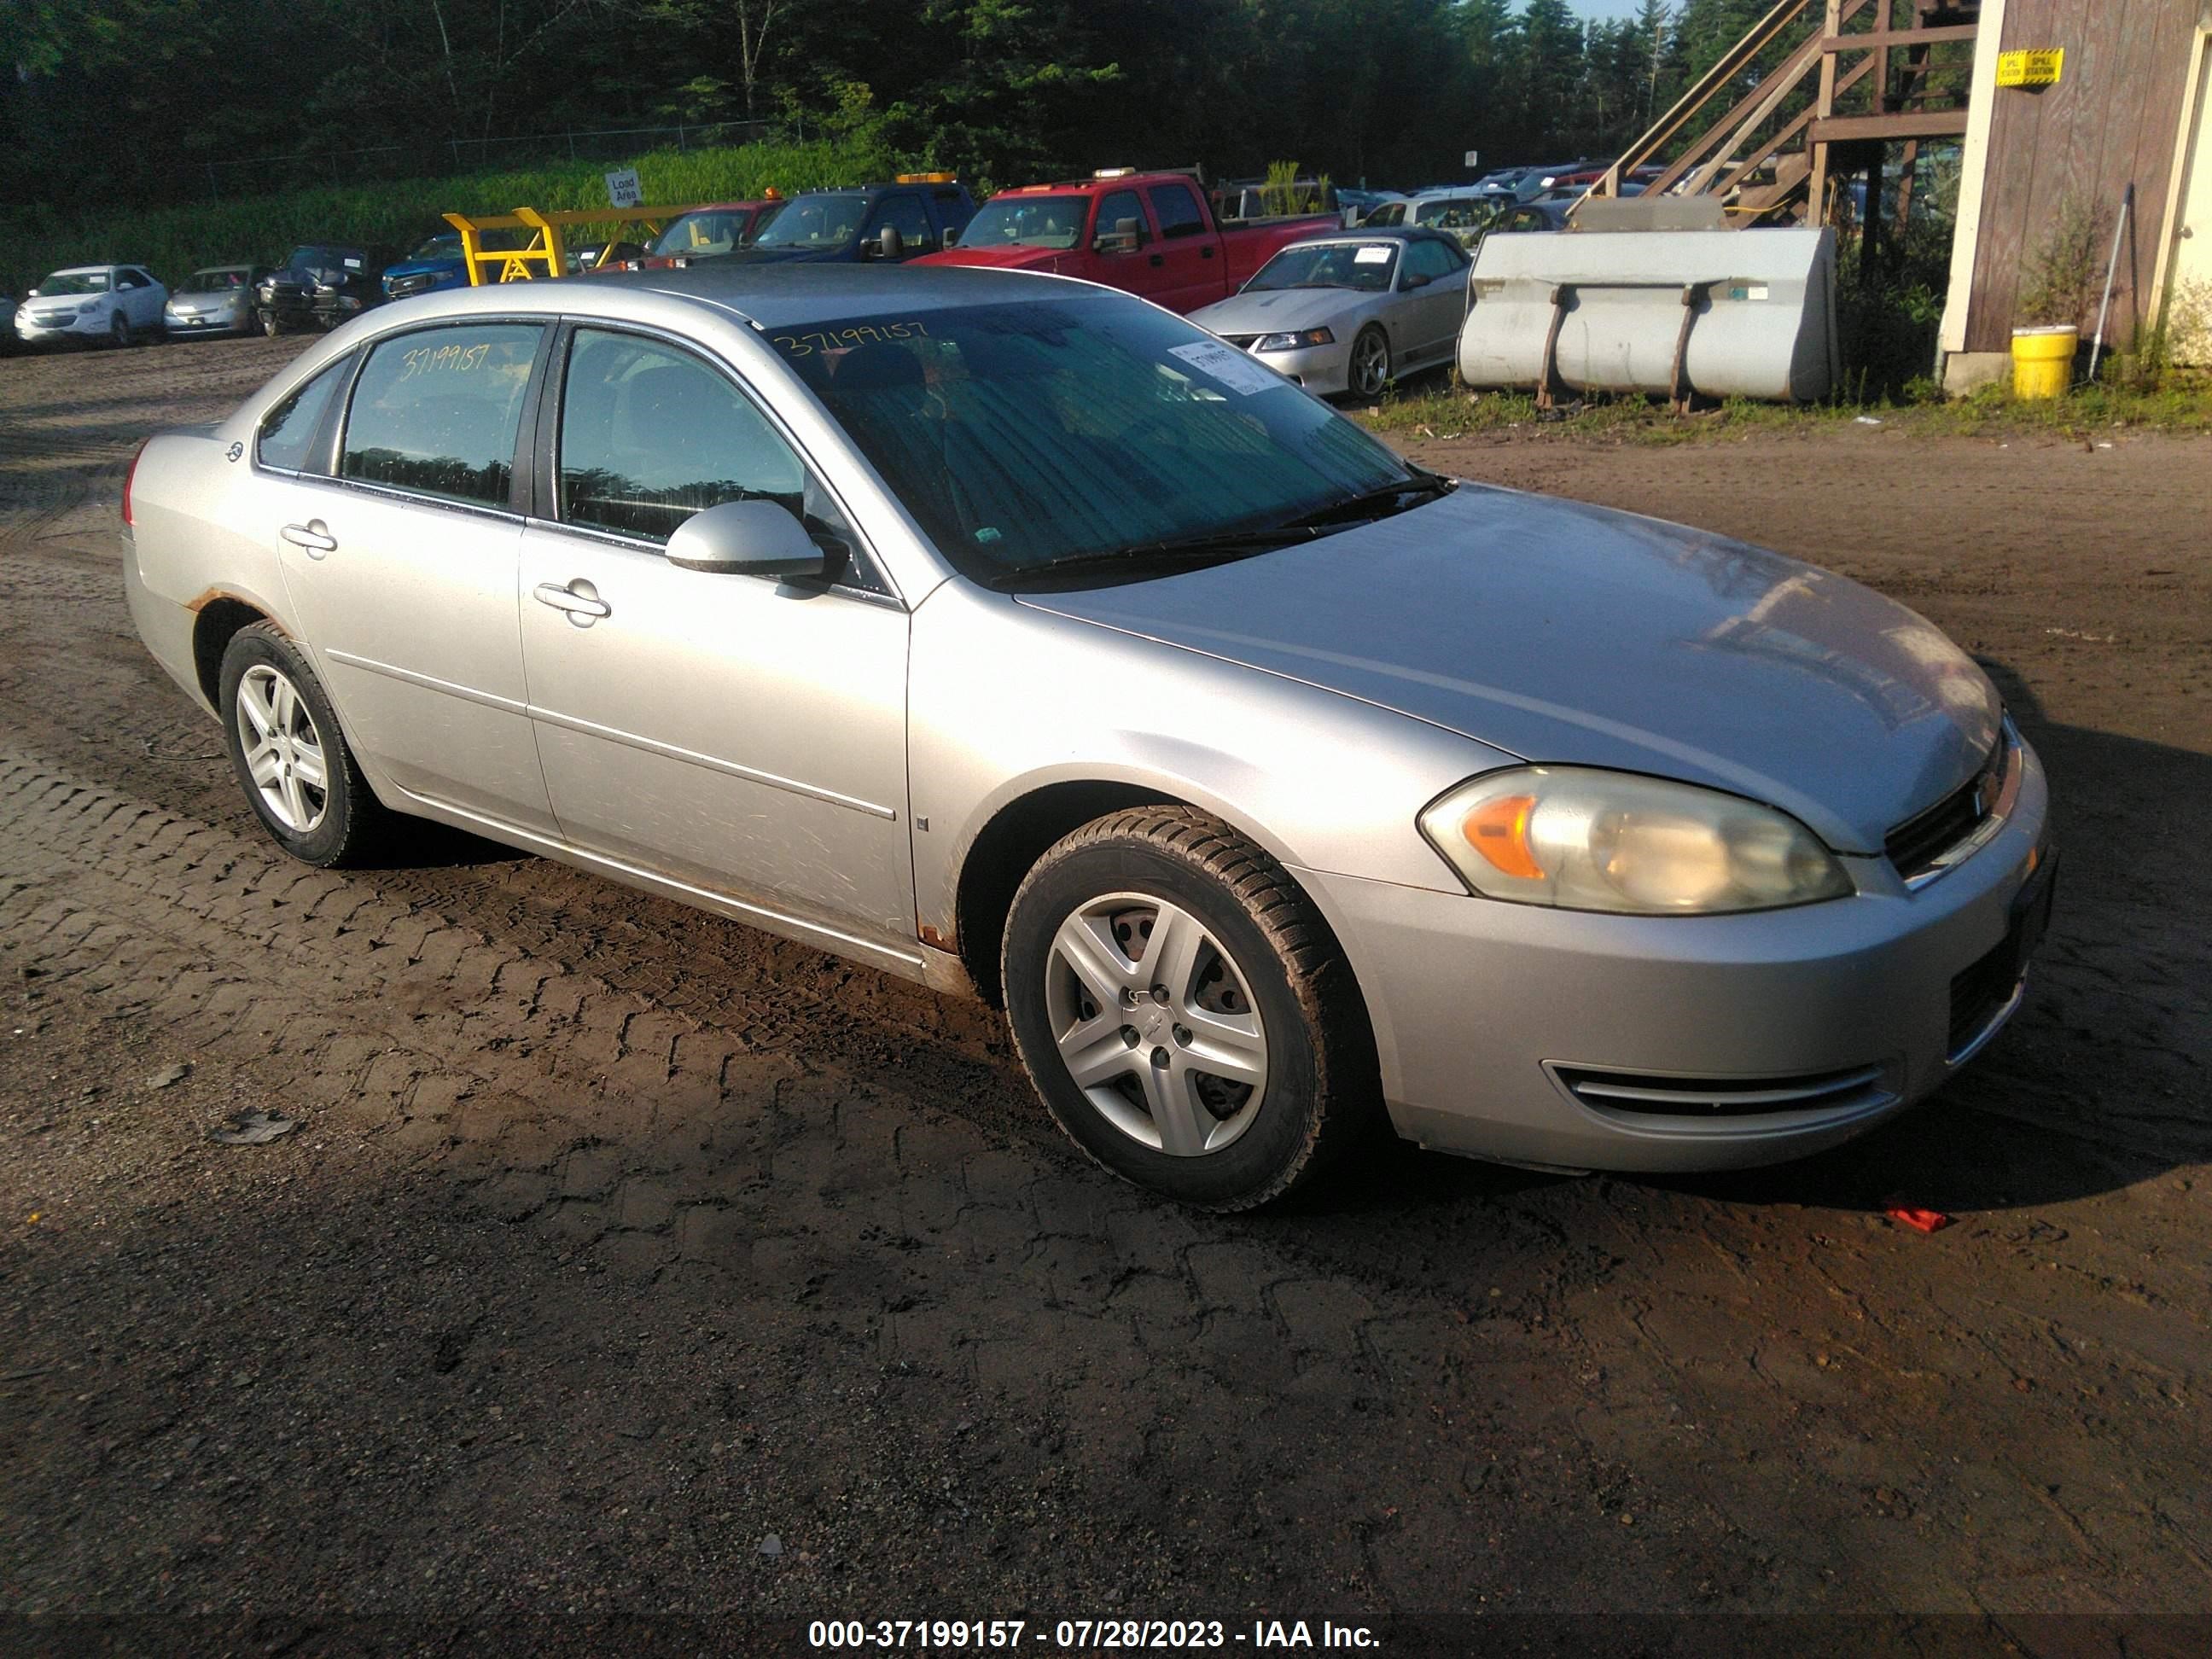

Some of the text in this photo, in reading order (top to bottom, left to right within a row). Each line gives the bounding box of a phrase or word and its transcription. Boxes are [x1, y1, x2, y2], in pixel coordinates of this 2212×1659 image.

[612, 177, 635, 189] Load
[616, 190, 637, 201] Area
[774, 322, 928, 357] 37199157
[399, 343, 492, 382] 37199157
